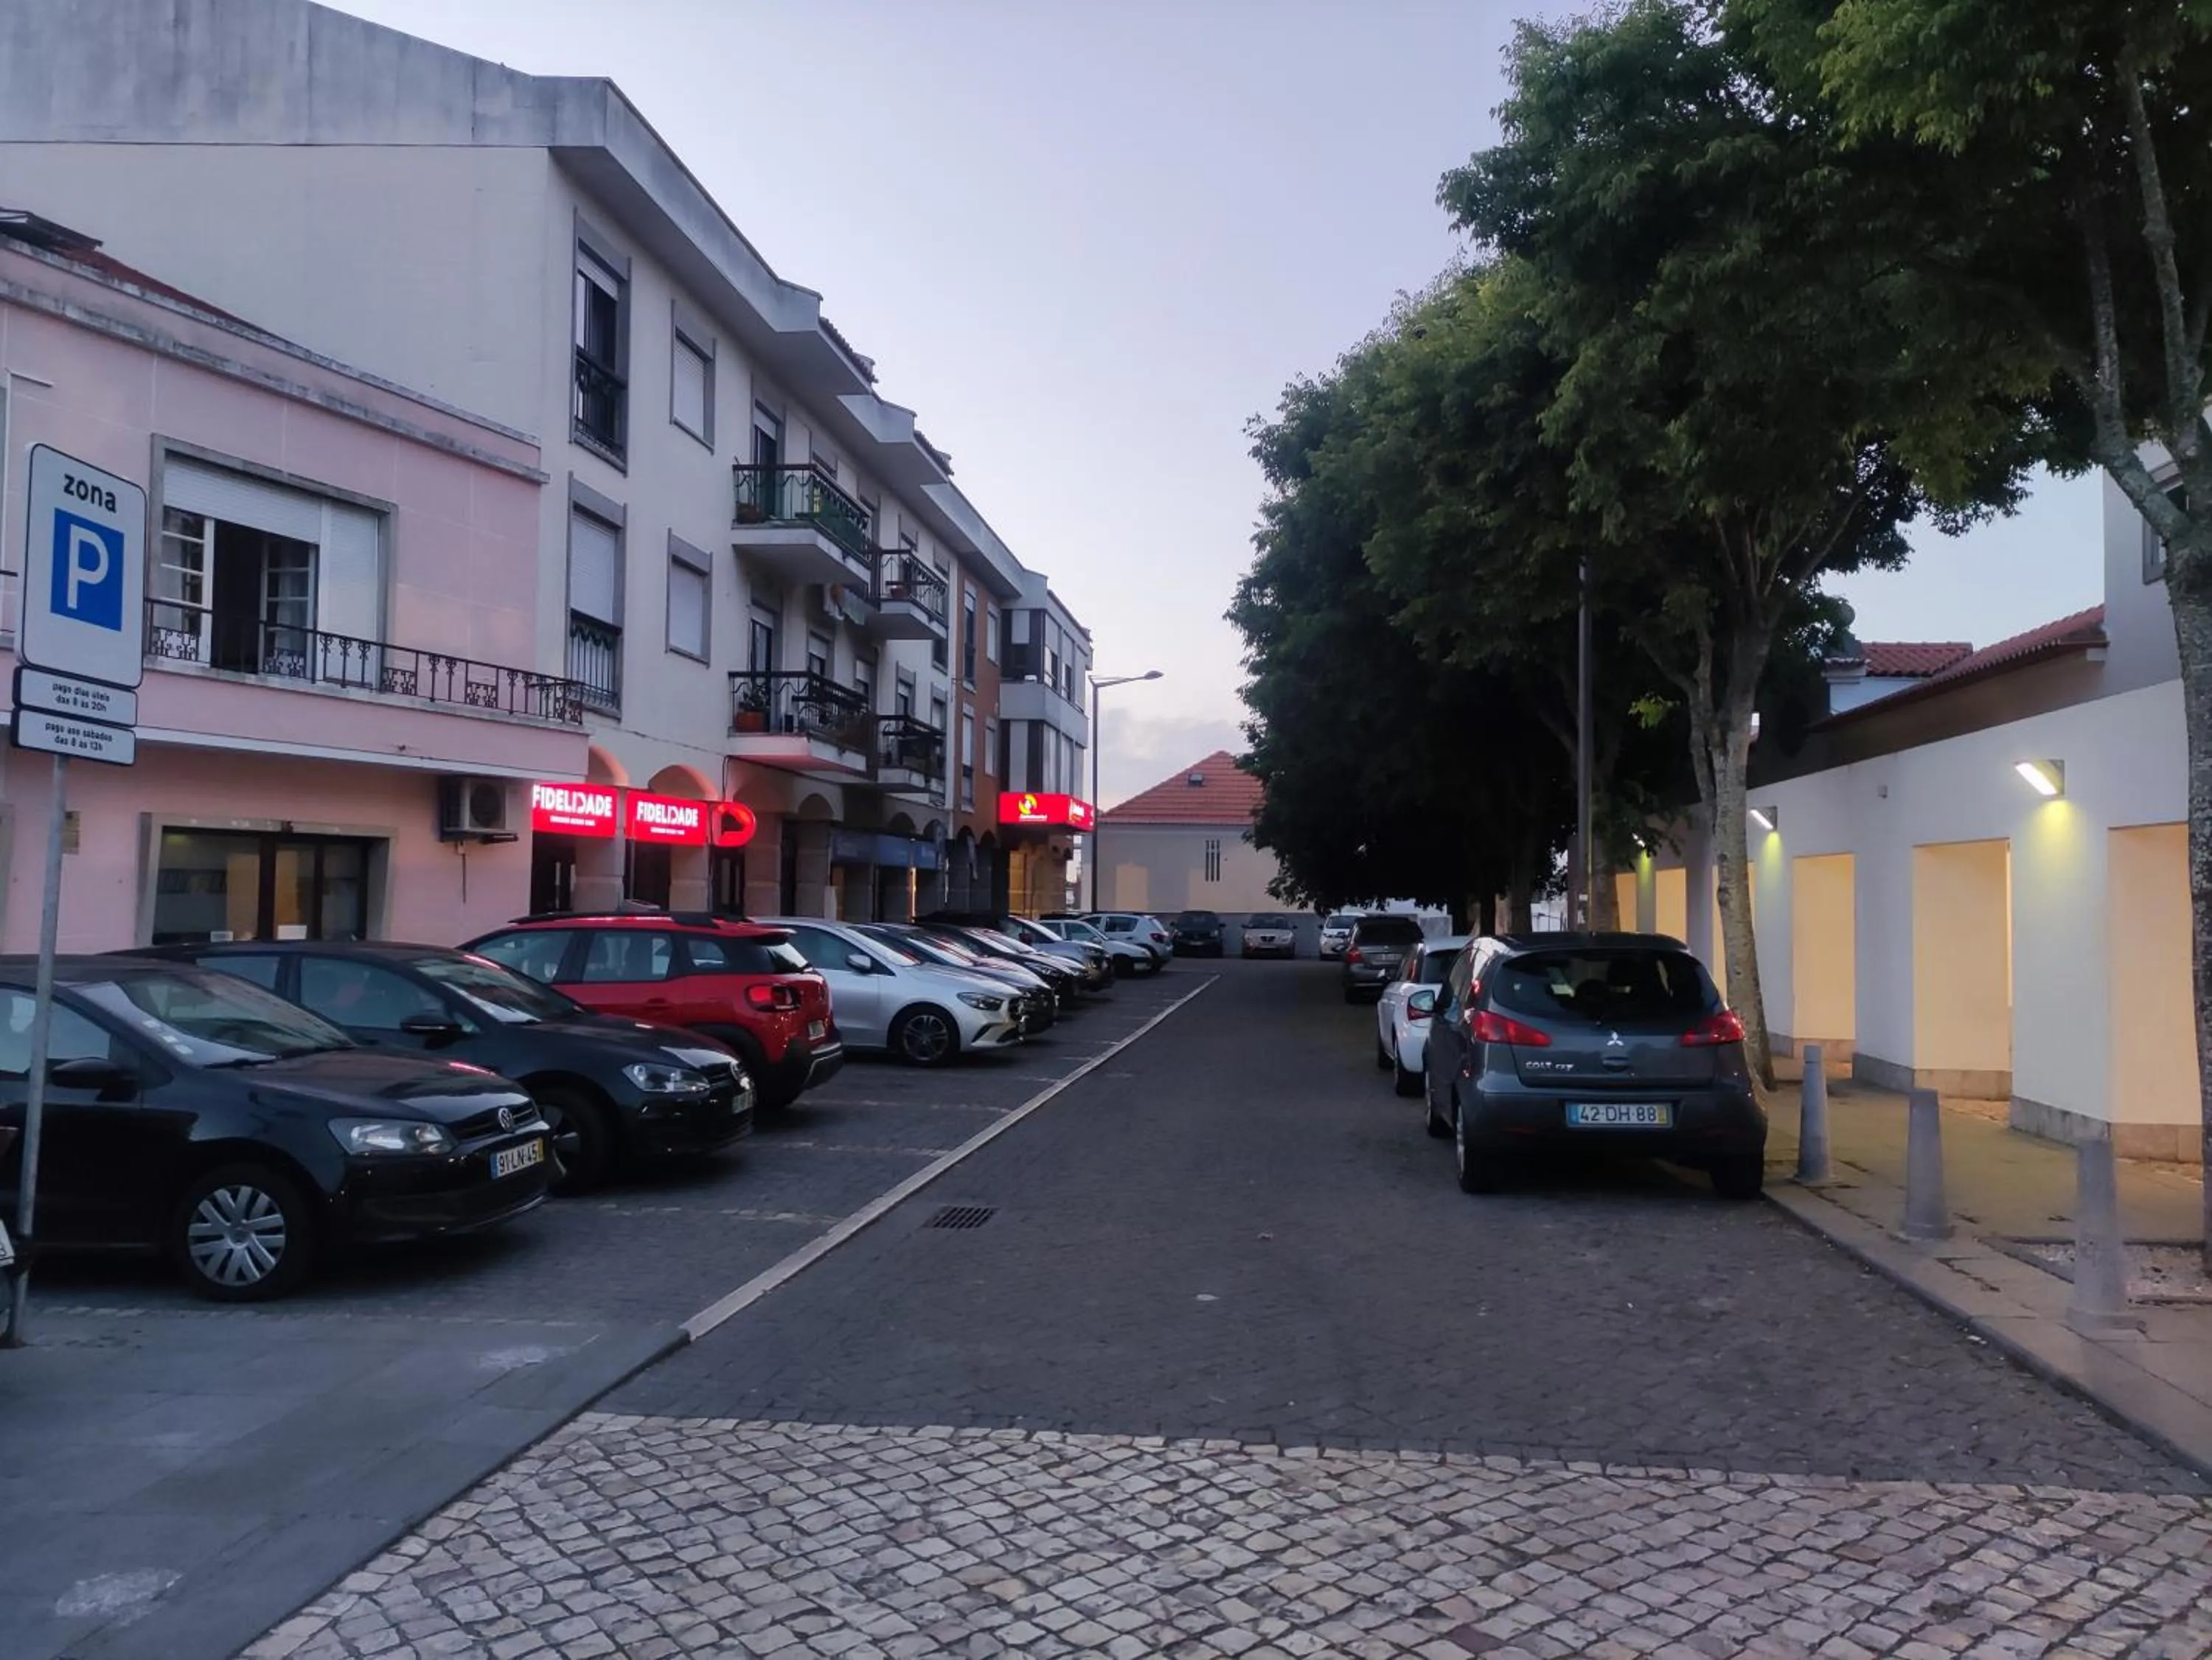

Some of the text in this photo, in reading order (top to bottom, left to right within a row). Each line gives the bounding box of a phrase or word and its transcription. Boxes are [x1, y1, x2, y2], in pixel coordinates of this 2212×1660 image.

[63, 473, 116, 514] zona
[67, 523, 110, 610] P
[532, 784, 613, 817] FIDELIDADE
[636, 801, 698, 827] FIDELIDADE
